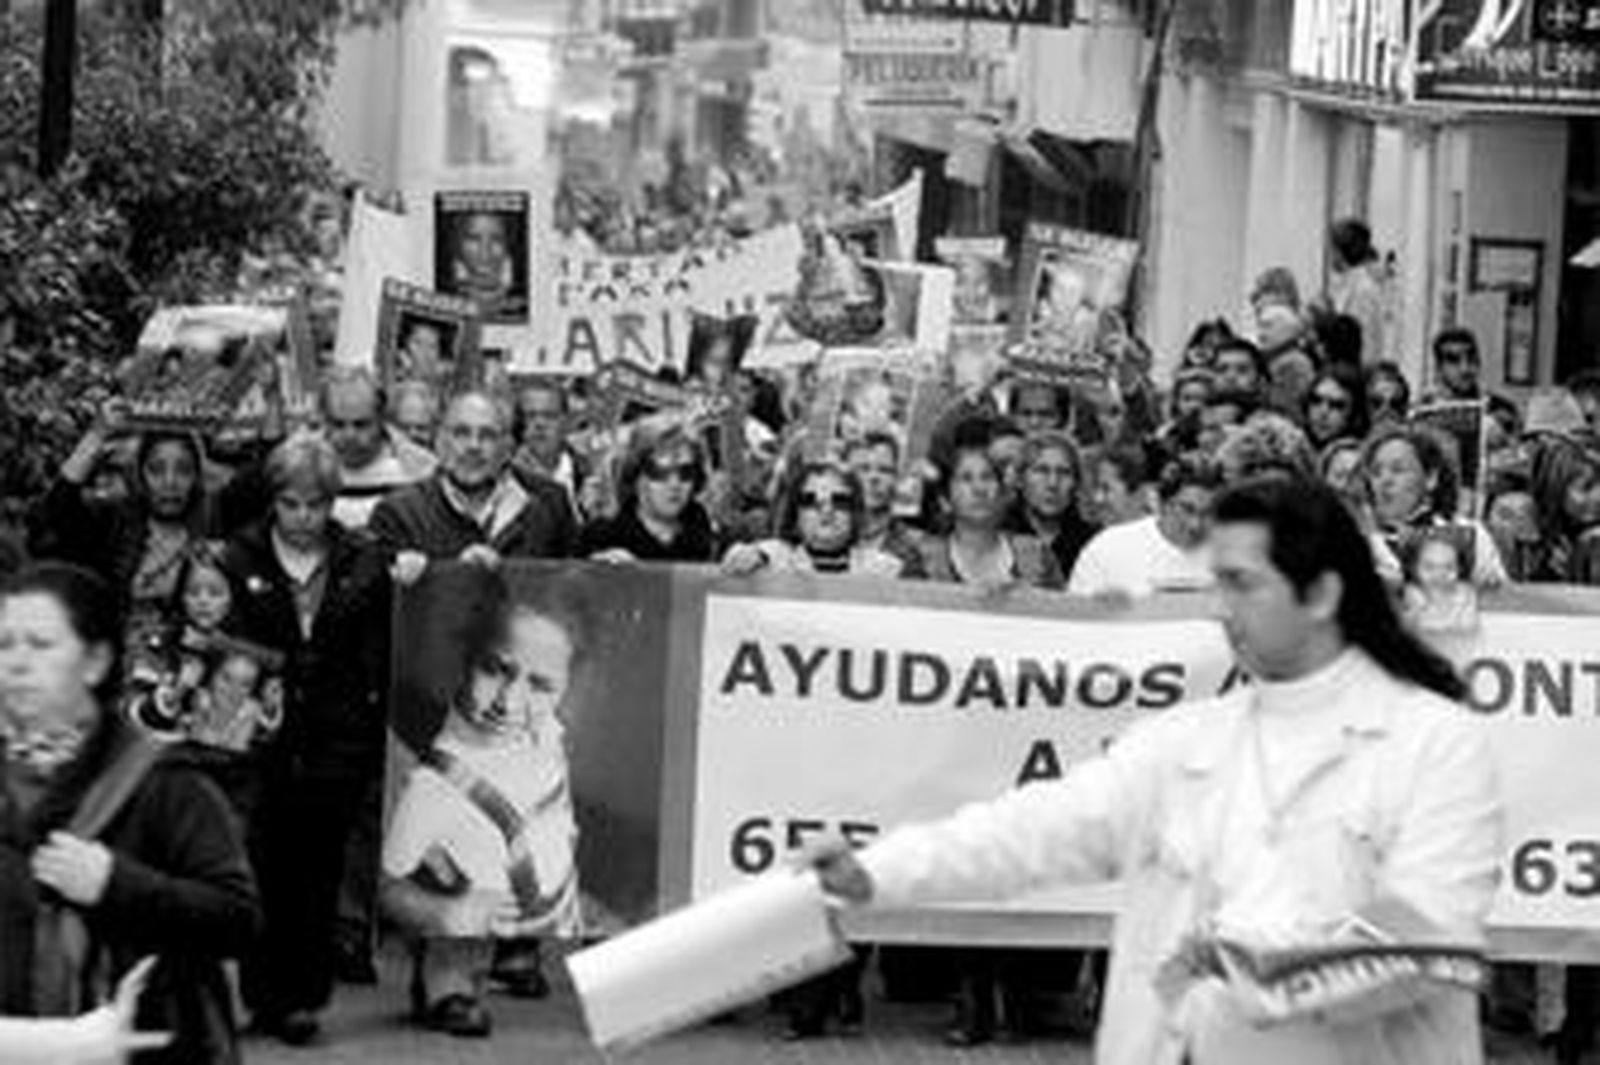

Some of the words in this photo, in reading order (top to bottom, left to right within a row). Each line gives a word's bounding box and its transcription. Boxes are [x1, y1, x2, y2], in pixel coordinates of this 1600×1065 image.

[721, 641, 1186, 710] AYUDANOS
[1016, 739, 1062, 789] A
[1512, 839, 1600, 899] 63
